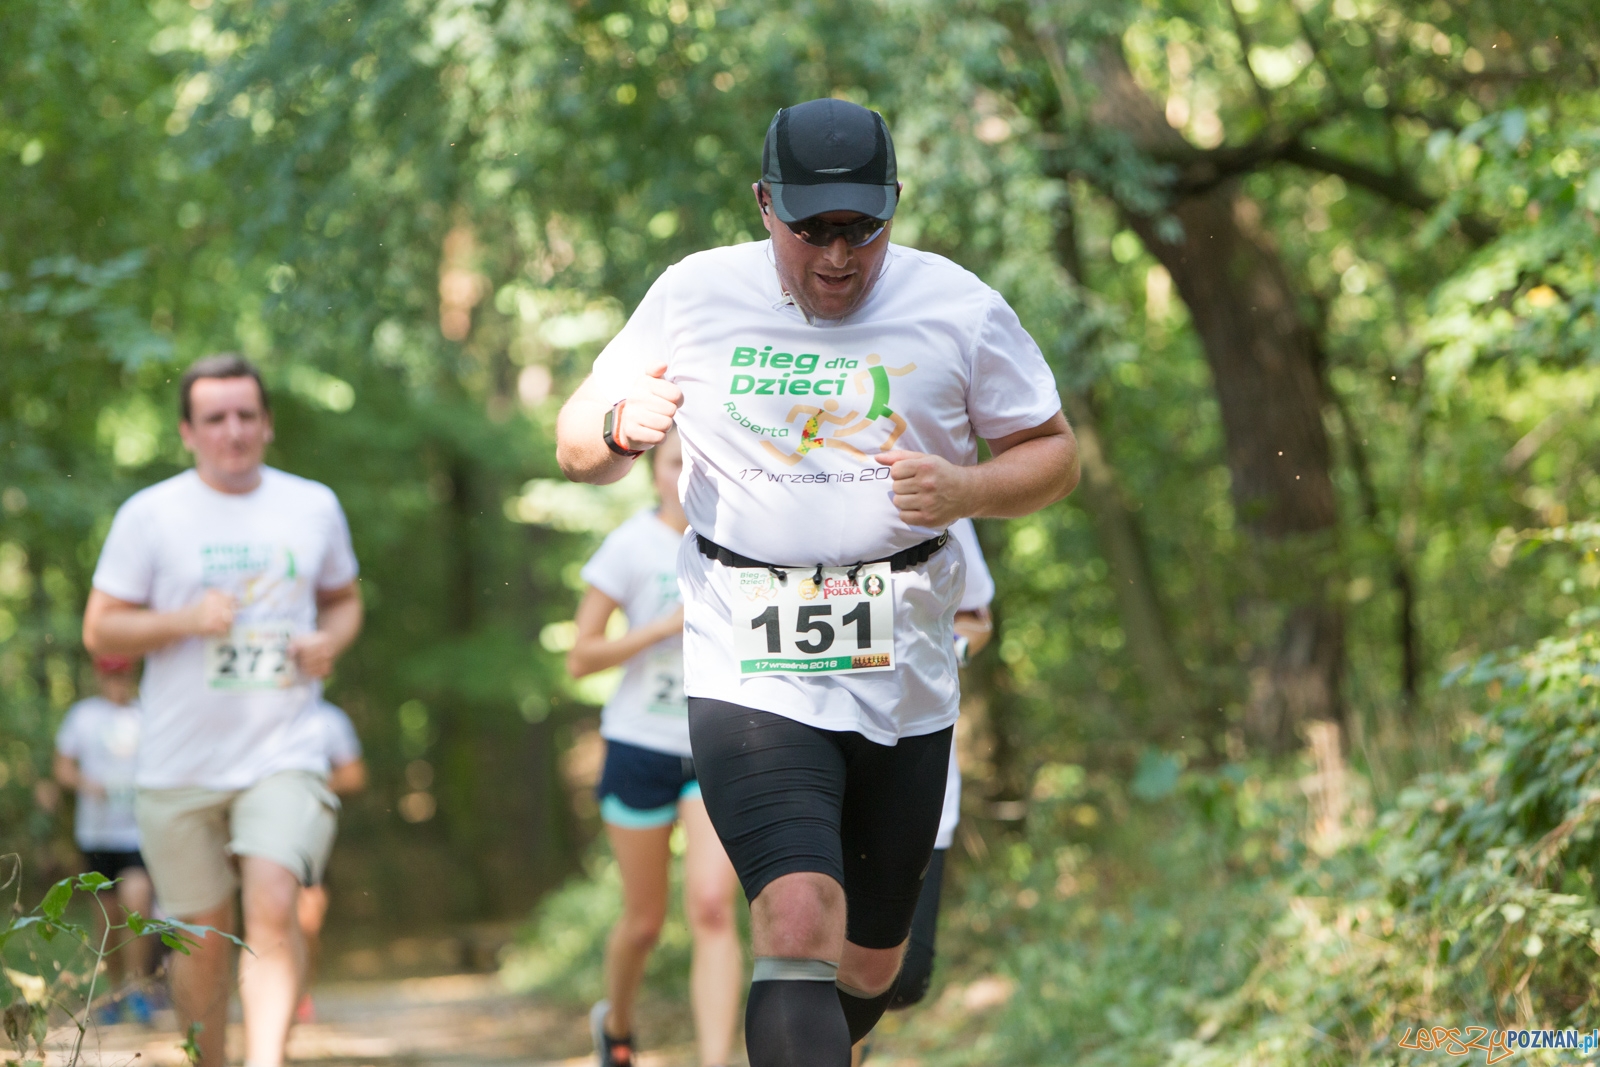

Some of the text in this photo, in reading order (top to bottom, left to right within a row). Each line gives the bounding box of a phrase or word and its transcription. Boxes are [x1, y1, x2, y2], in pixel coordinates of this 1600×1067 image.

[730, 345, 859, 375] Bieg dla
[729, 373, 848, 396] Dzieci
[723, 401, 789, 438] Roberta
[739, 466, 891, 484] 17 września 20
[740, 571, 759, 579] Bieg
[823, 587, 862, 600] POLSKA
[751, 601, 872, 654] 151
[755, 662, 769, 670] 17
[809, 660, 838, 670] 2016
